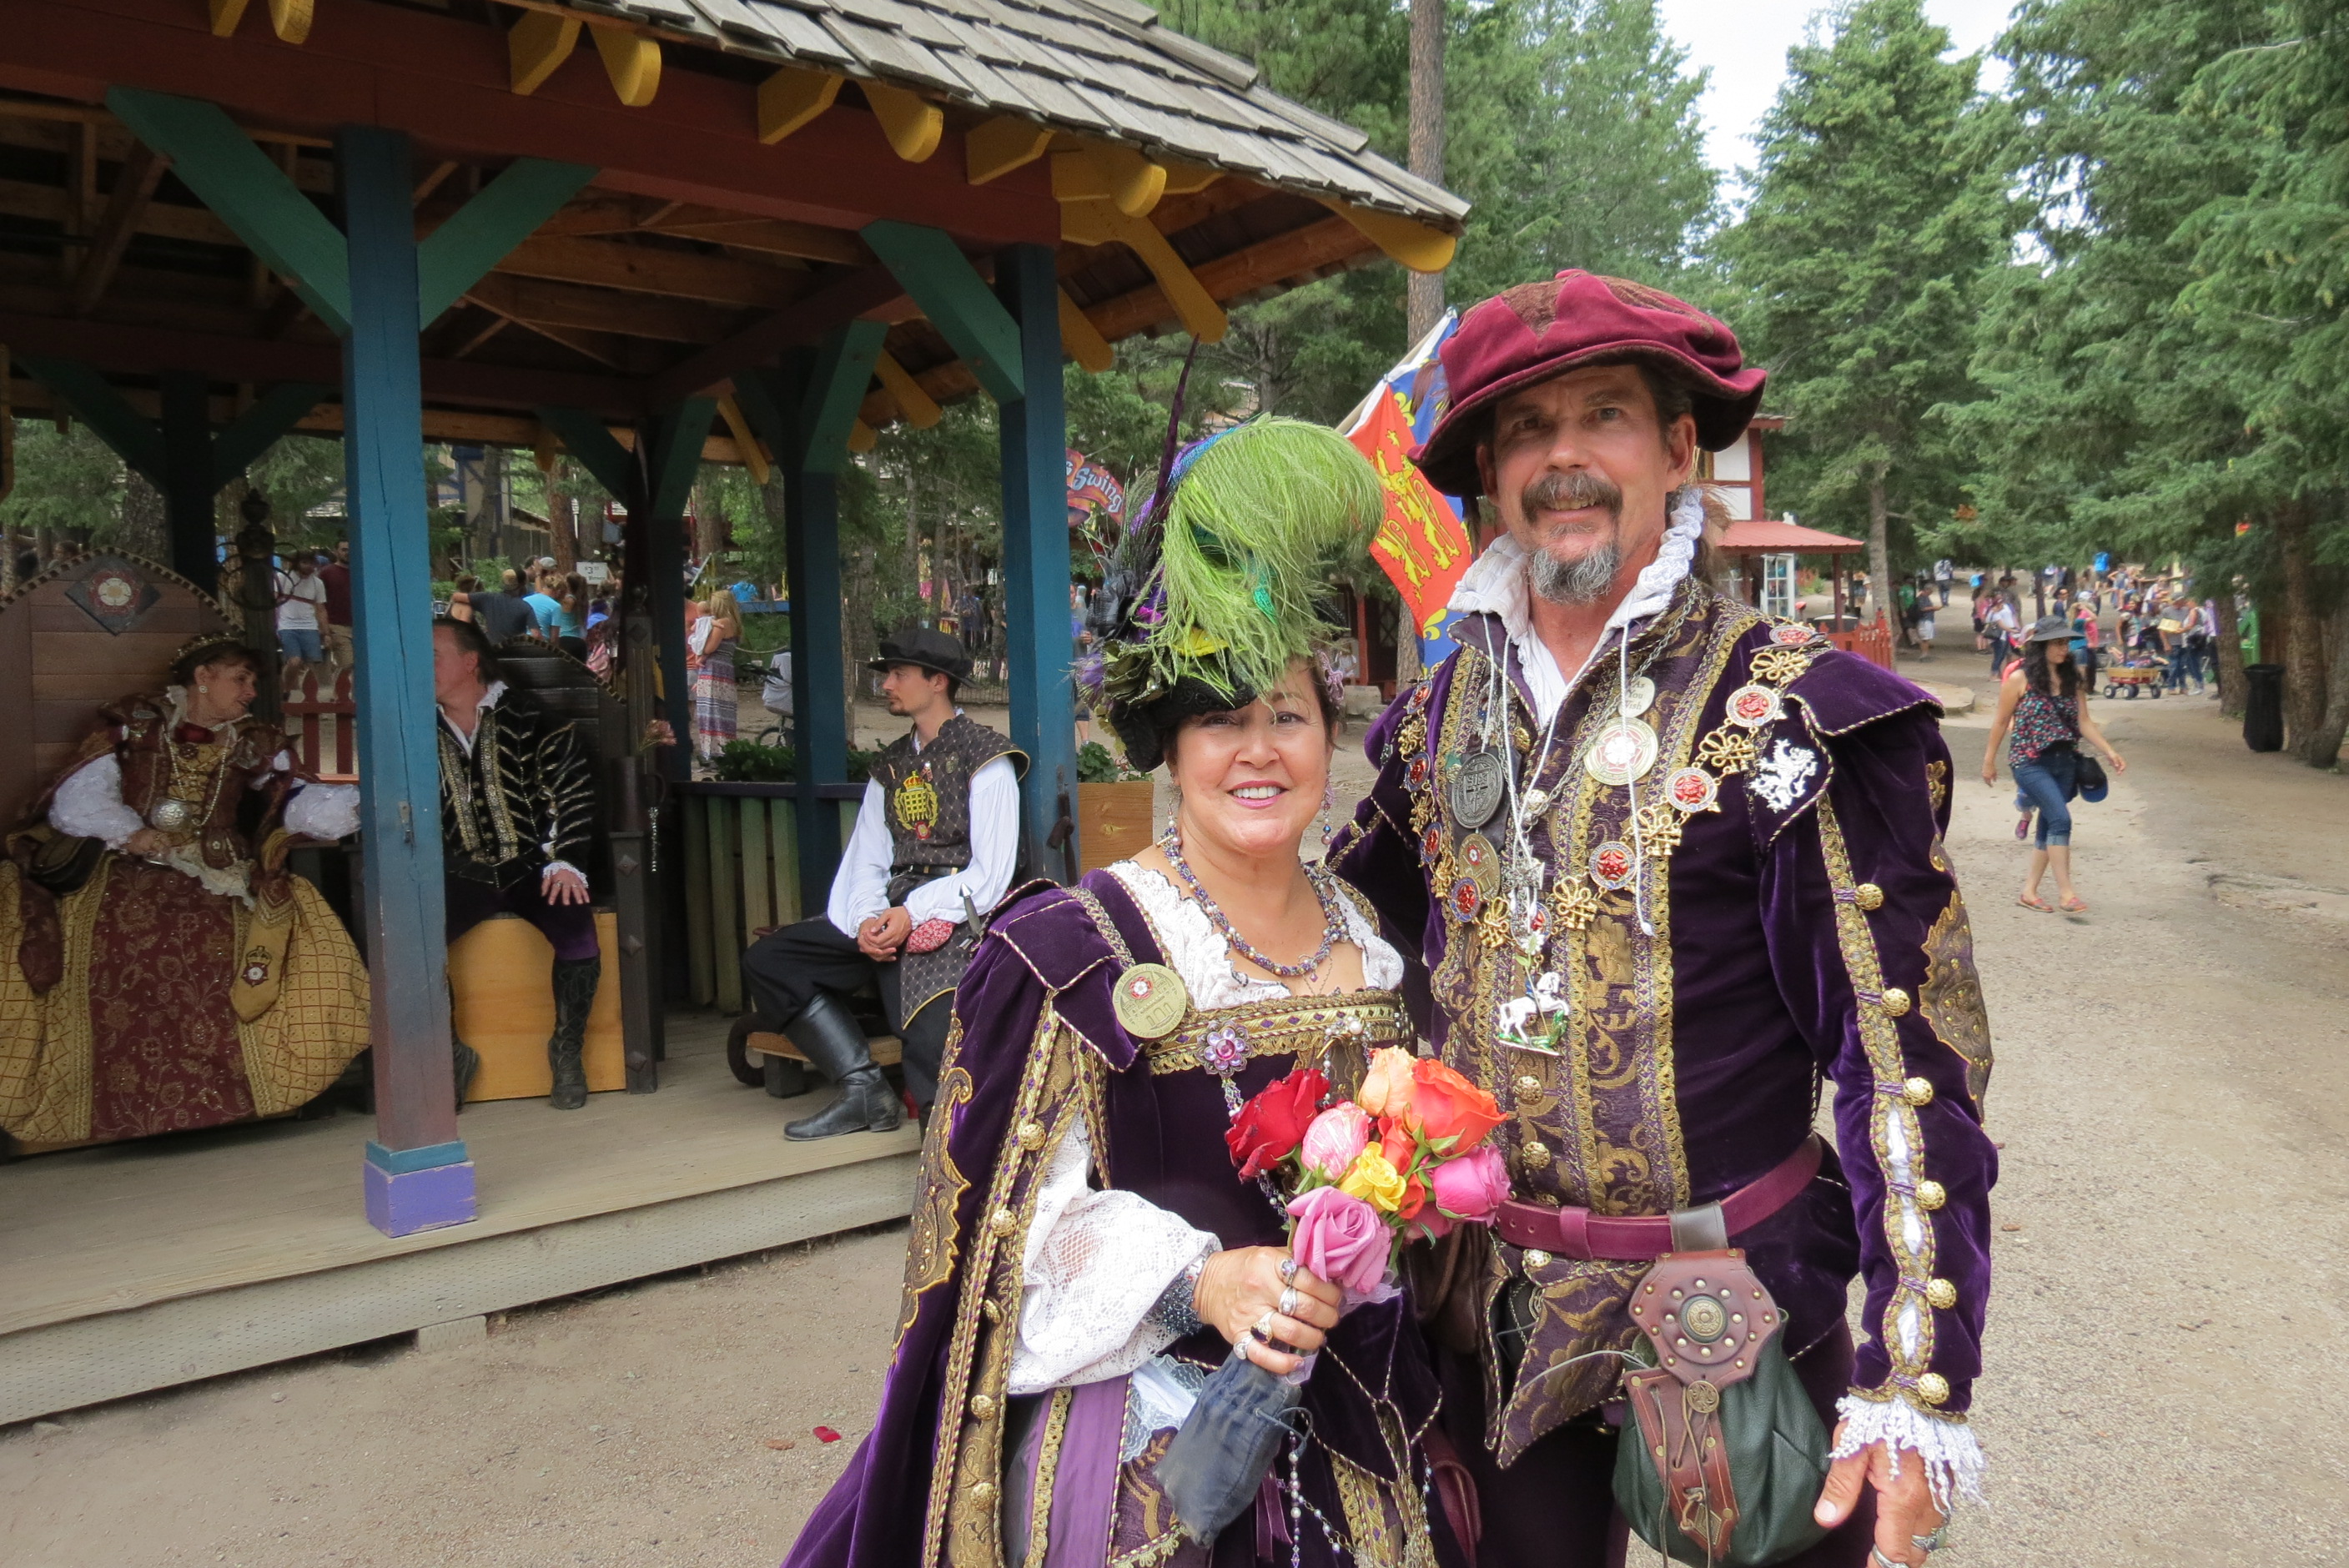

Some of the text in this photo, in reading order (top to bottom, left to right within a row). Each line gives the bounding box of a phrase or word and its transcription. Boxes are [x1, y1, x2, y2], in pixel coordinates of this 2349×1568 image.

[1073, 467, 1122, 513] Swing
[1632, 681, 1646, 689] As
[1627, 689, 1643, 699] You
